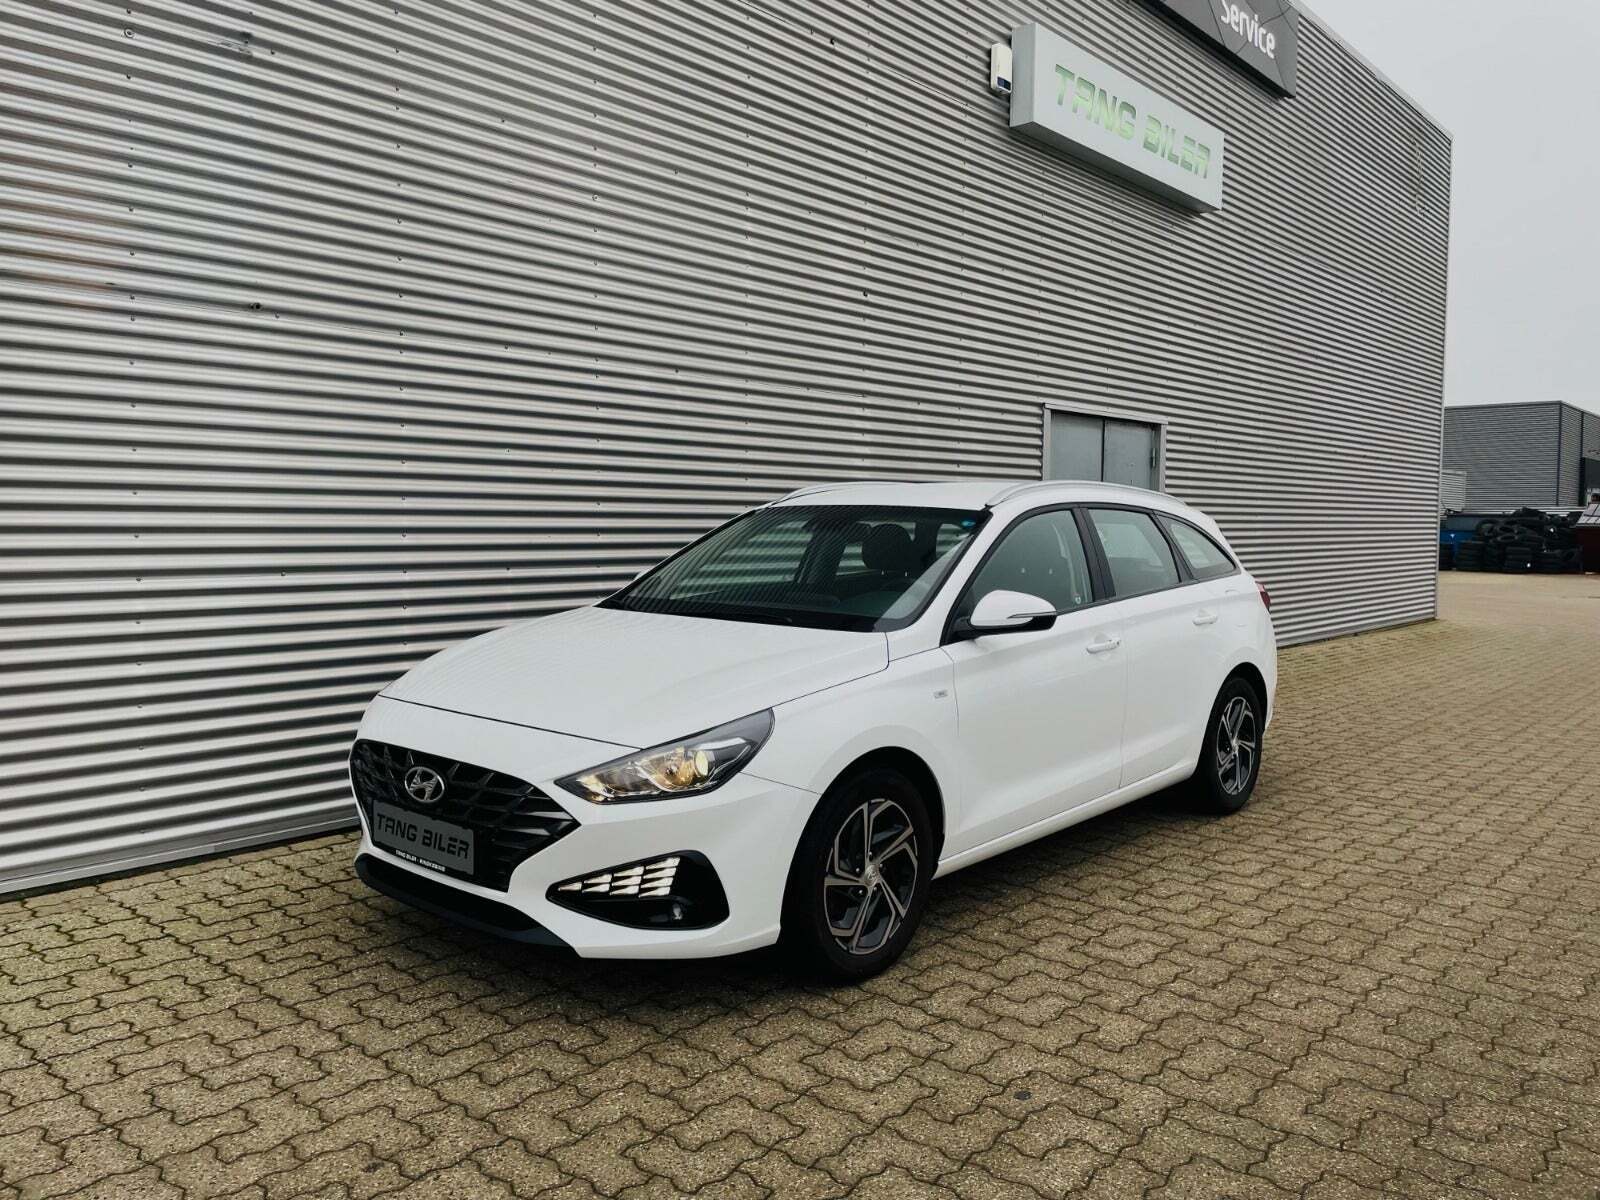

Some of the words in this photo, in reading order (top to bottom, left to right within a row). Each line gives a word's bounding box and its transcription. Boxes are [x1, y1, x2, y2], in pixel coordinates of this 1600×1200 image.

[1221, 0, 1275, 59] Service
[1055, 63, 1137, 141] TANG
[1143, 114, 1211, 179] BILER
[376, 813, 418, 842] TANG
[421, 828, 470, 859] BILER
